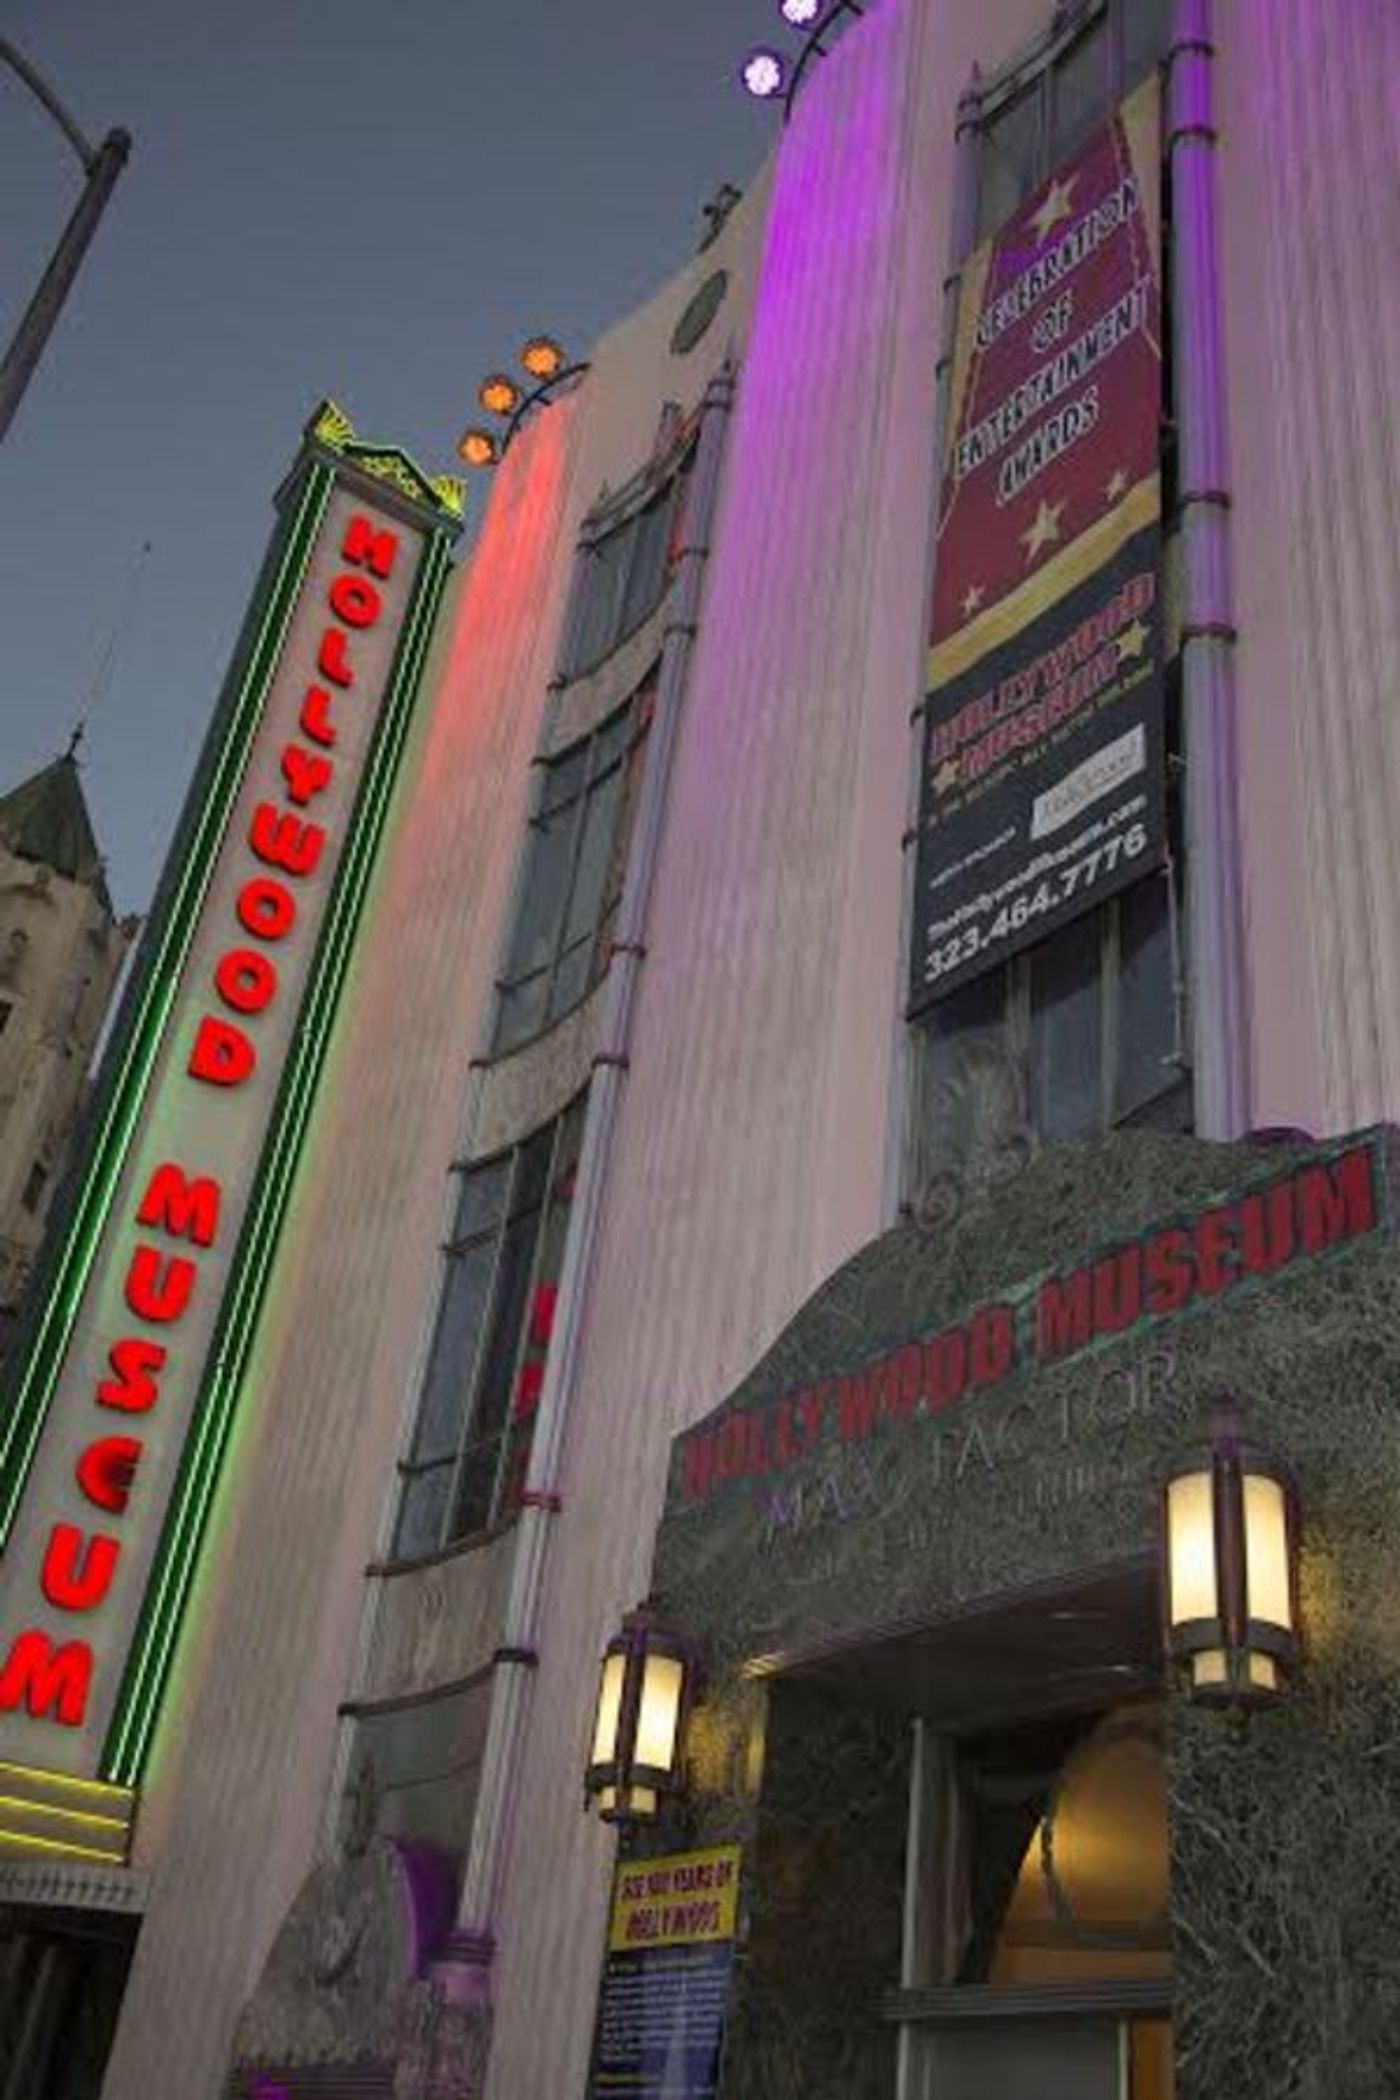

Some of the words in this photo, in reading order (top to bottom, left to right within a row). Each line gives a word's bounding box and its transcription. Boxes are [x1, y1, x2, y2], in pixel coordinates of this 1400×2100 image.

[974, 178, 1138, 352] CELEBRATION
[1031, 288, 1075, 354] OF
[955, 273, 1157, 482] ENTERTAINMENT
[998, 385, 1099, 506] AWARDS
[188, 514, 398, 1088] HOLLYWOOD
[923, 822, 1148, 984] 323.464.7776
[684, 1302, 1016, 1498] HOLLYWOOD
[1036, 1142, 1379, 1368] MUSEUM
[0, 1162, 221, 1728] MUSEUM
